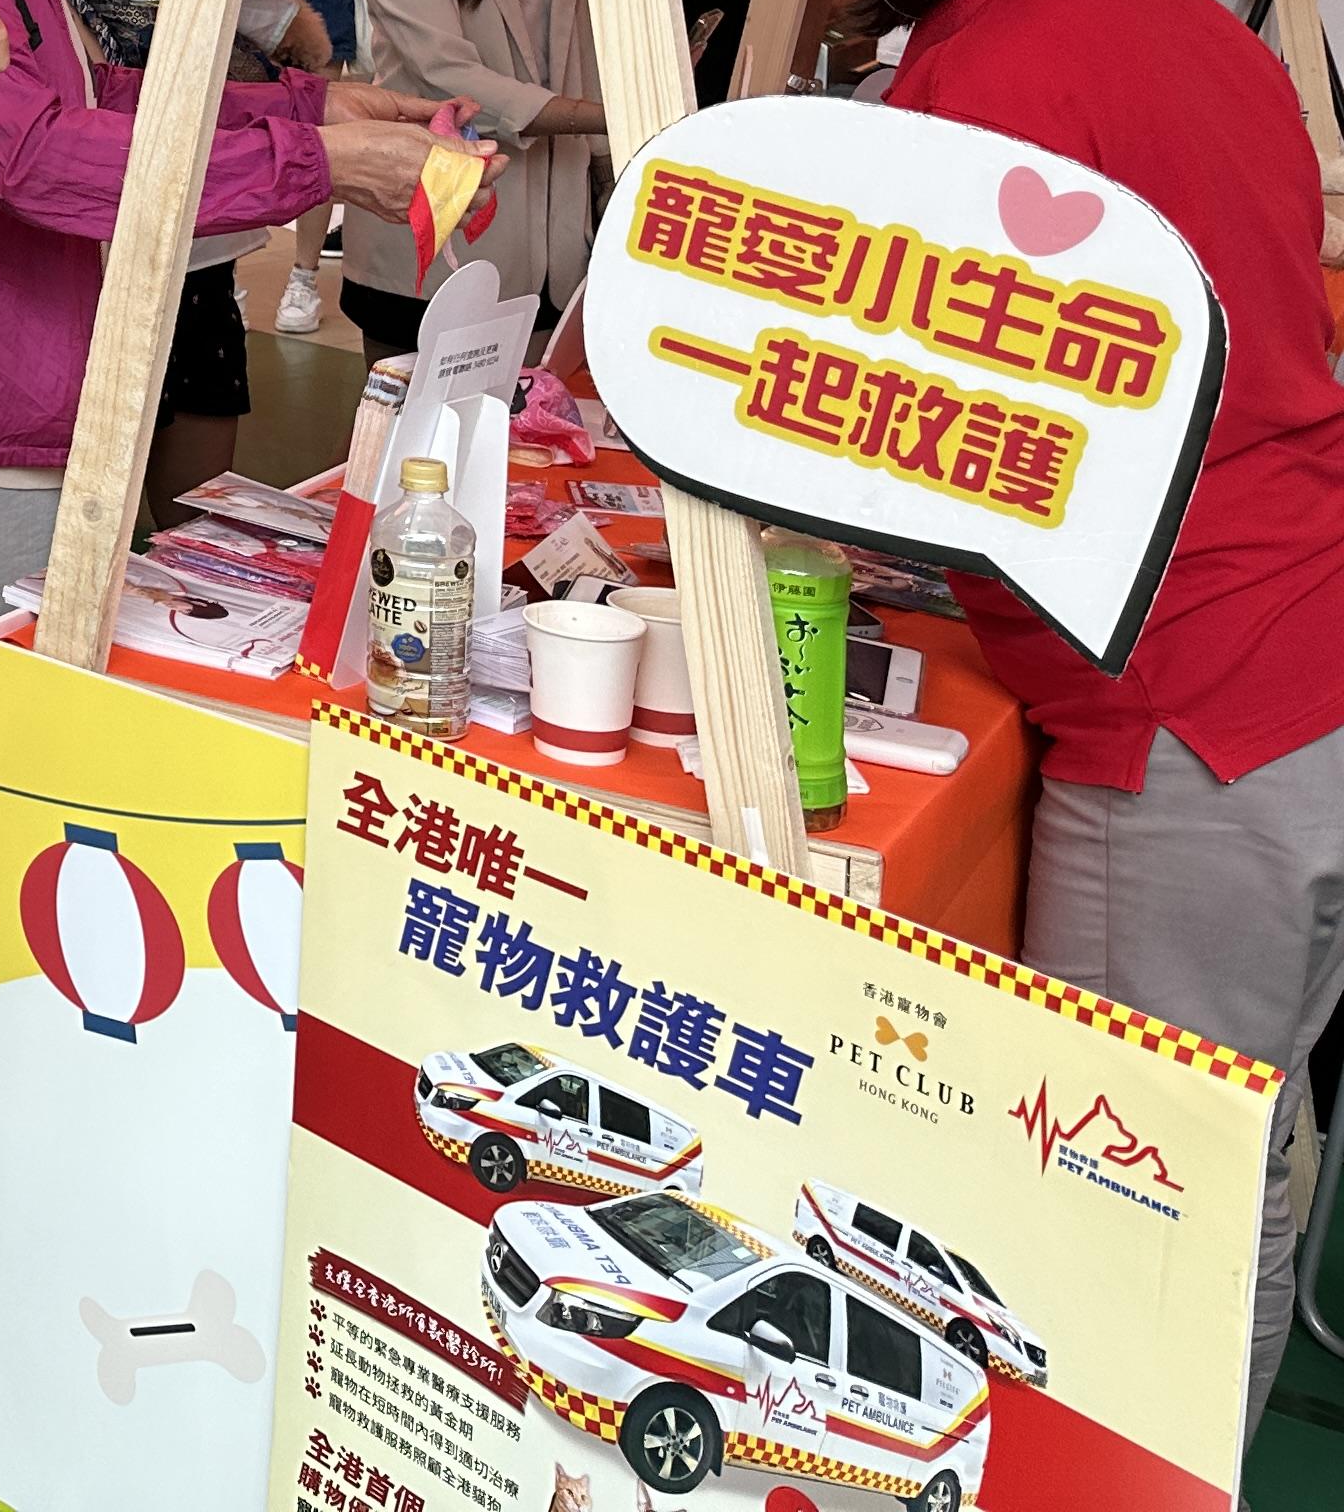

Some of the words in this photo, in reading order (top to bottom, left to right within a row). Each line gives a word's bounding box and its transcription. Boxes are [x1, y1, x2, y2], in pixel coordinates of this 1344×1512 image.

[638, 170, 1166, 397] 寵愛小生命
[660, 337, 1074, 518] 一起救護
[773, 582, 816, 597] 伊藤園
[336, 770, 589, 901] 全港唯一
[399, 877, 814, 1125] 寵物救護車
[862, 981, 948, 1029] 香港寵物會
[829, 1033, 883, 1073] PET
[896, 1064, 976, 1116] CLUB
[858, 1079, 897, 1106] HONG
[901, 1098, 940, 1125] KONG
[1057, 1156, 1084, 1176] PET
[1086, 1170, 1181, 1221] AMBULANCE
[330, 1338, 474, 1442] 延長動物拯救的黃金期
[332, 1311, 522, 1443] 平等的緊急專業醫療支援服務
[841, 1398, 860, 1415] PET
[862, 1403, 916, 1436] AMBULANCE
[305, 1427, 426, 1512] 全港首個
[328, 1391, 502, 1512] 寵物救護服務照顧全港貓狗
[330, 1366, 520, 1501] 寵物在短時間內得到適切治療
